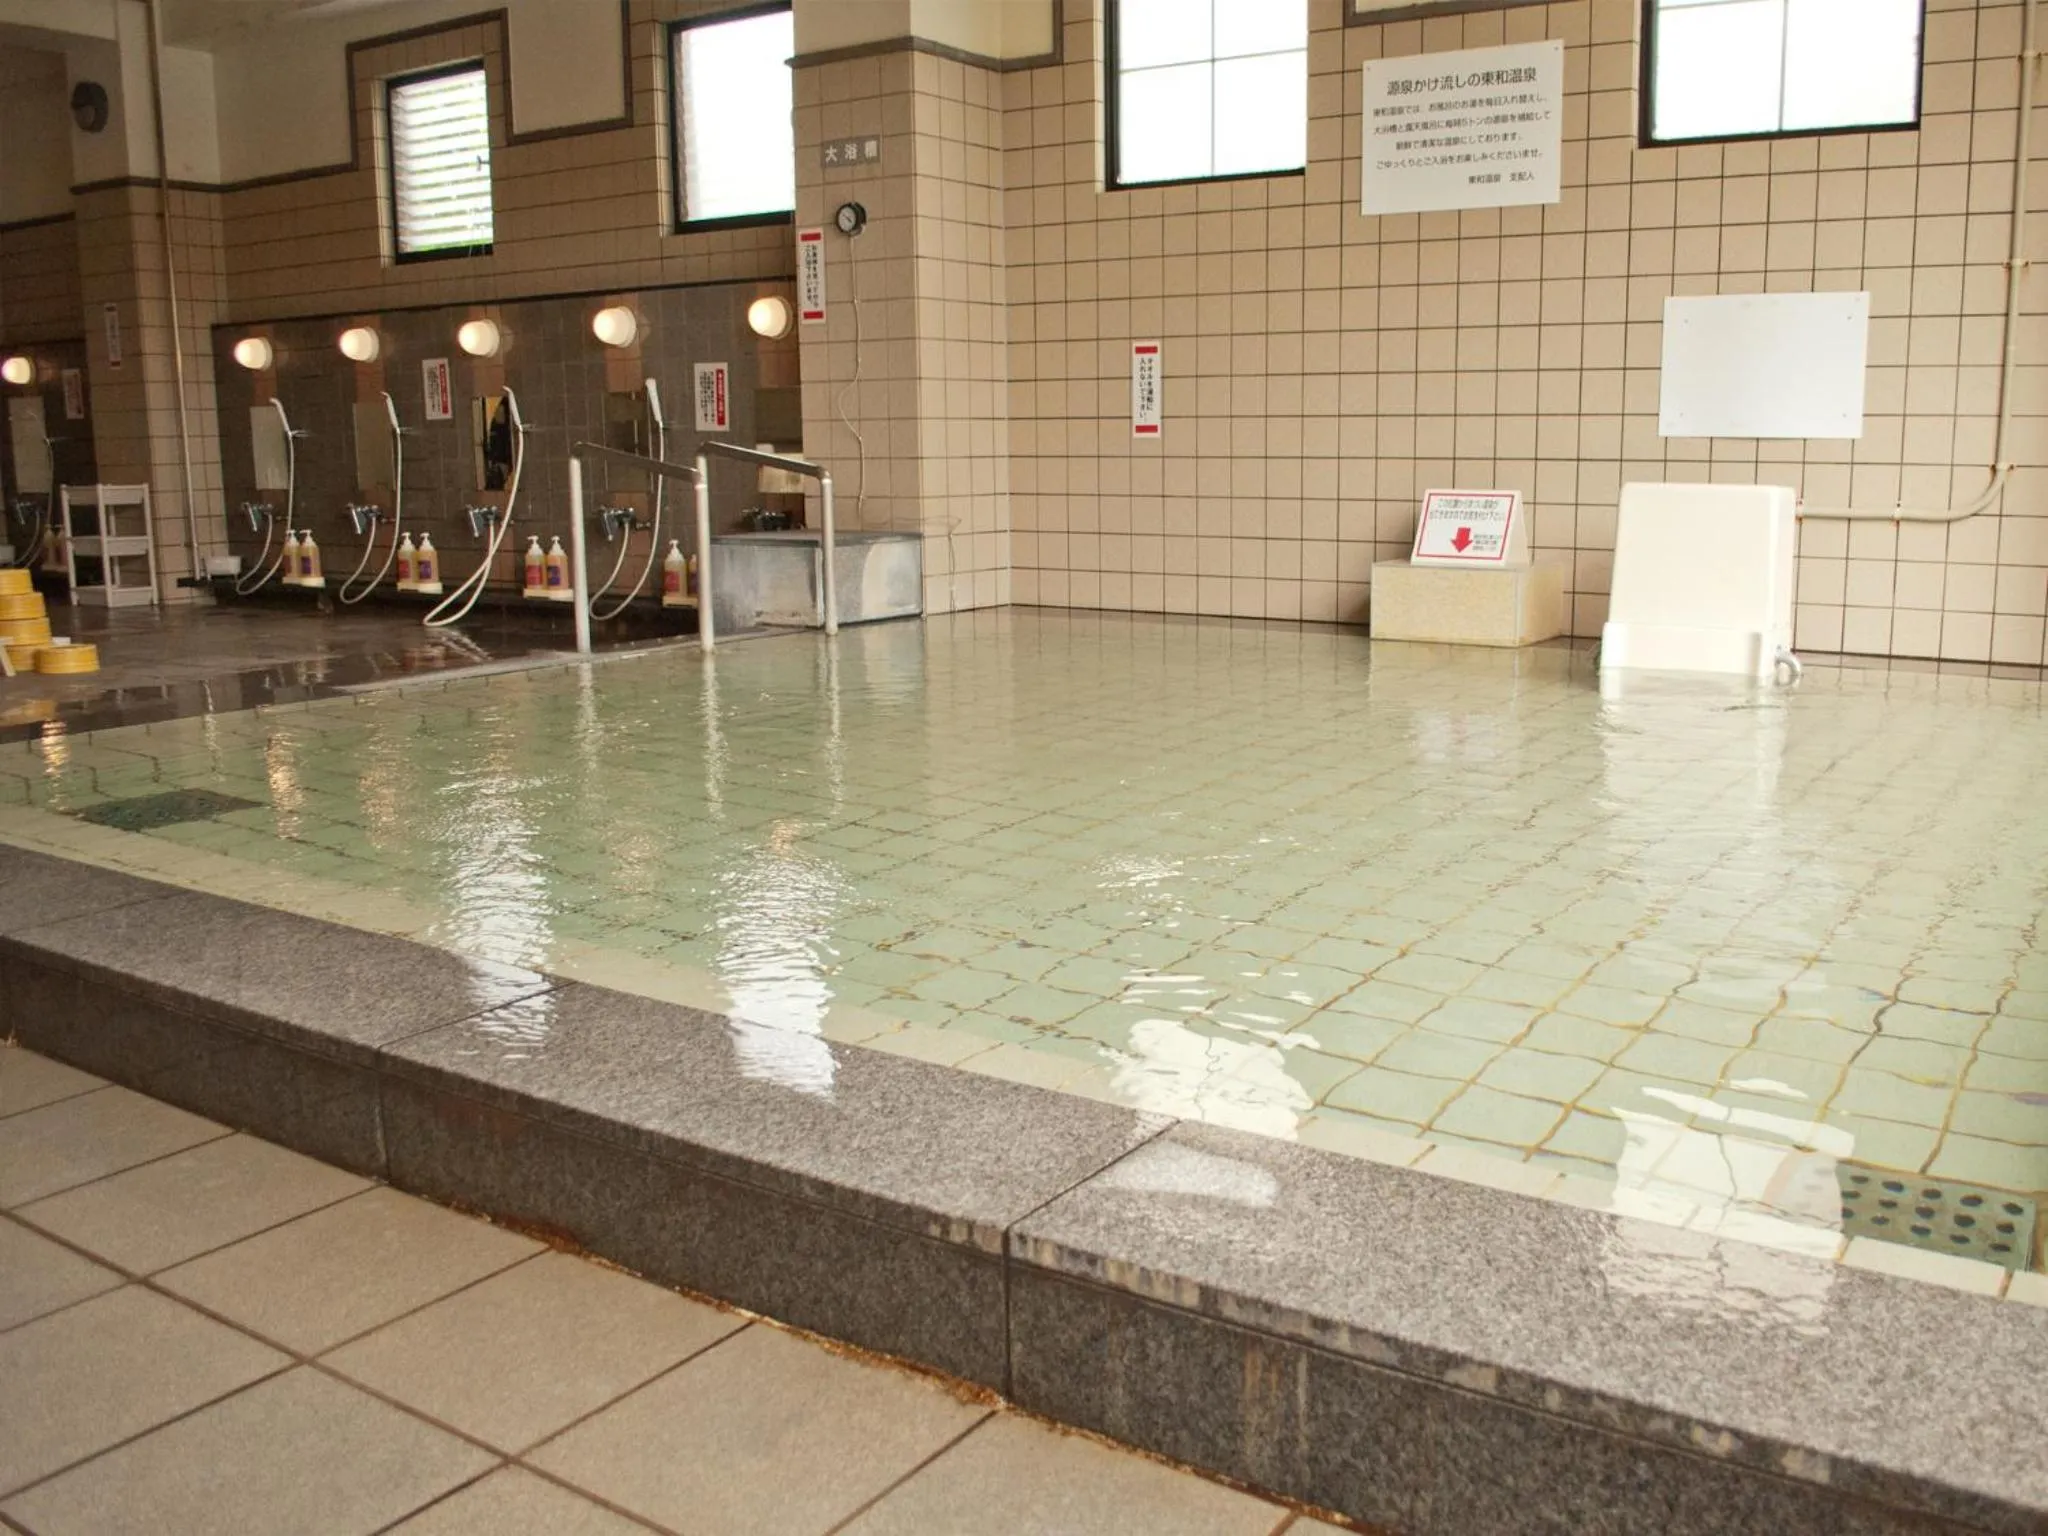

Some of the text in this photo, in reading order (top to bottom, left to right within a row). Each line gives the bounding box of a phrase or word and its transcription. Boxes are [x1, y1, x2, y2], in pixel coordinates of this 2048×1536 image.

[1386, 67, 1537, 96] 源泉かけ流しの東和温泉
[824, 140, 878, 163] 大浴
[1468, 170, 1535, 185] 東和温泉 支配人
